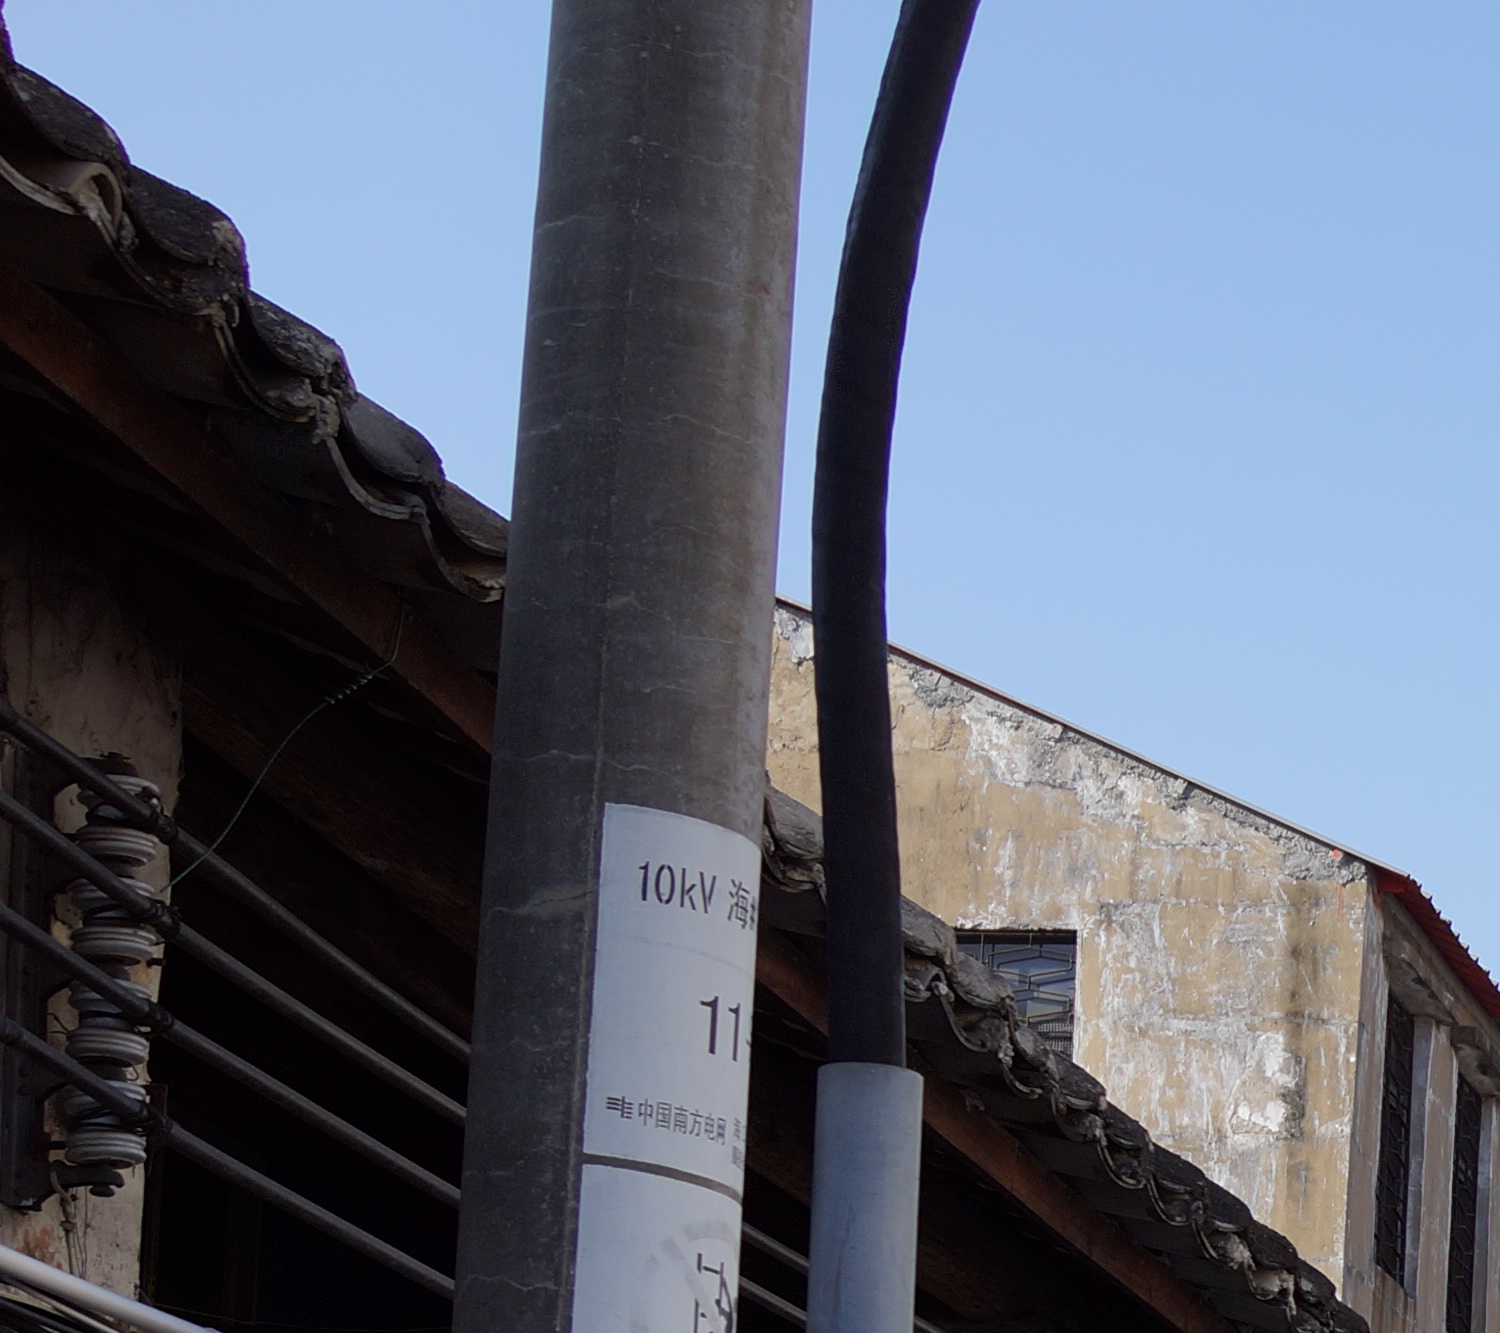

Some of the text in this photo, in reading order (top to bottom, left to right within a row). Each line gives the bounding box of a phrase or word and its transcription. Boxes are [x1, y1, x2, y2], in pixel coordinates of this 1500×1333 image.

[638, 860, 717, 914] 10kV
[699, 995, 751, 1063] 11
[637, 1097, 727, 1147] 中国南方电网
